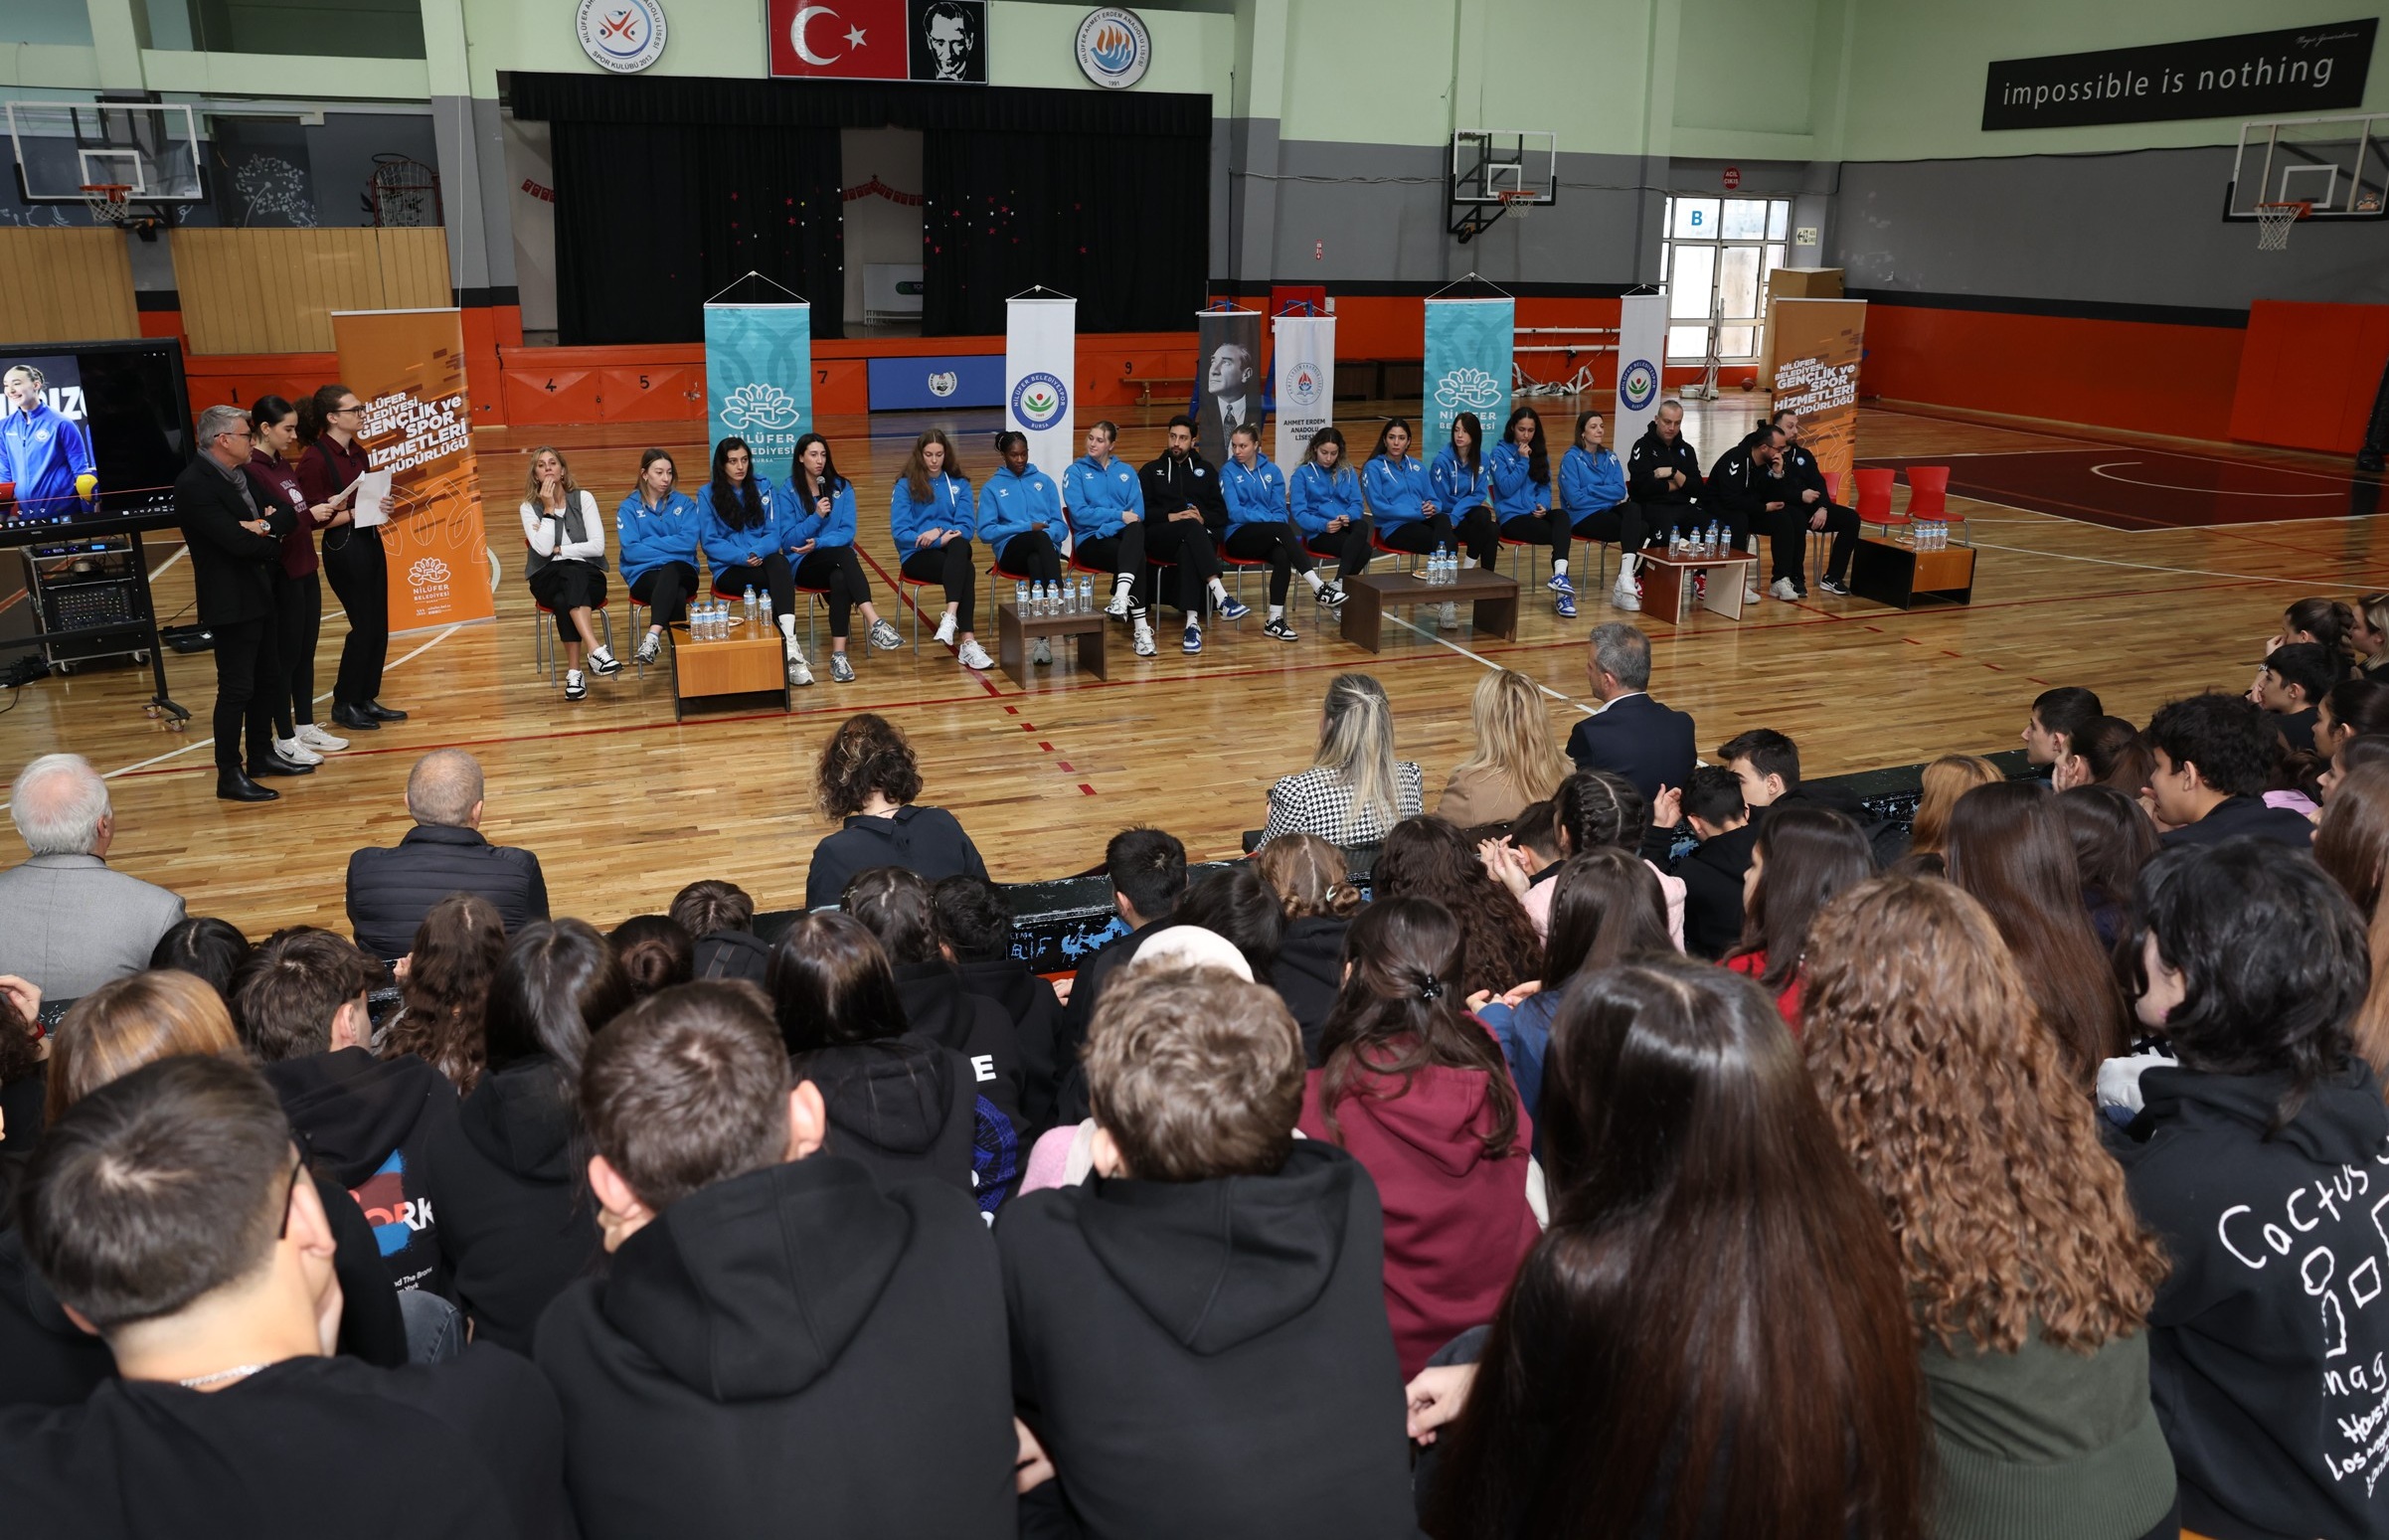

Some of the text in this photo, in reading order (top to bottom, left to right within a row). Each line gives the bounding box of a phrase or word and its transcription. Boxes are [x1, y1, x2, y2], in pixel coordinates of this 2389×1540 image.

[1086, 15, 1101, 34] AHMET
[1123, 16, 1145, 44] ANADOLU
[593, 51, 610, 66] SPOR
[2002, 56, 2334, 109] impossible is nothing
[1691, 211, 1703, 226] B
[1124, 362, 1132, 375] 9
[1775, 362, 1824, 381] BELEDİYESİ
[1780, 358, 1816, 372] NİLÜFER
[545, 378, 557, 393] 4
[639, 375, 650, 390] 5
[816, 370, 828, 385] 7
[1777, 364, 1855, 390] GENÇLİK ve
[1810, 374, 1848, 393] SPOR
[231, 388, 239, 404] 1
[1013, 375, 1066, 407] NİLÜFER BELEDİYESPOR
[1774, 381, 1856, 412] HİZMETLERİ
[364, 396, 419, 424] LEDİYESİ
[365, 392, 407, 414] İLÜFER
[356, 396, 462, 440] GENÇLİK ve
[406, 412, 455, 438] SPOR
[751, 444, 794, 455] EDİYESİ
[413, 584, 449, 595] NİLÜFER
[2218, 1163, 2368, 1270] Cactus
